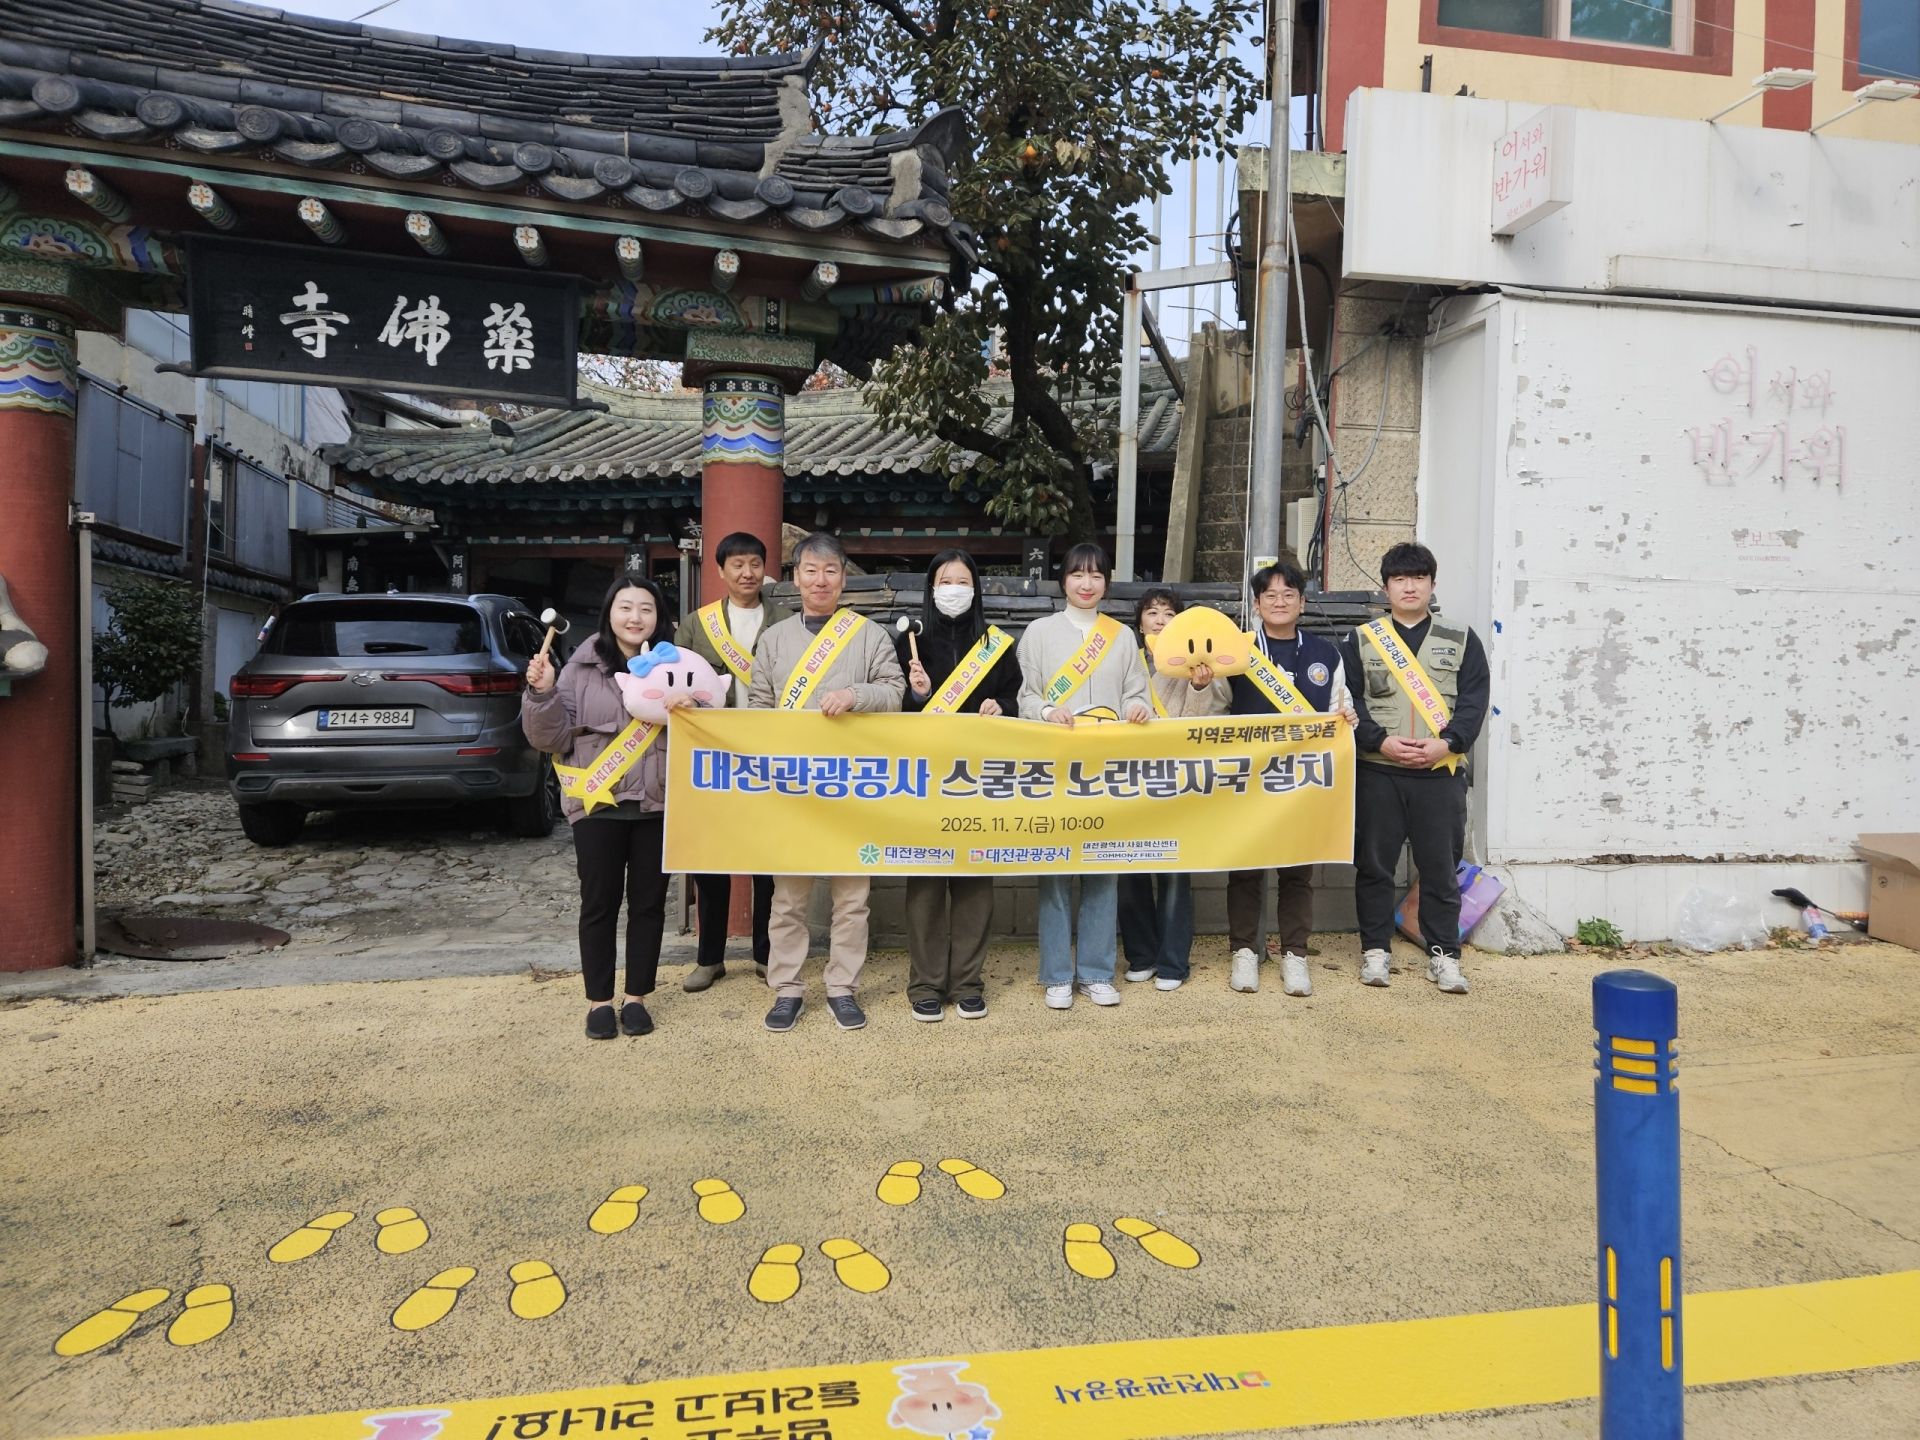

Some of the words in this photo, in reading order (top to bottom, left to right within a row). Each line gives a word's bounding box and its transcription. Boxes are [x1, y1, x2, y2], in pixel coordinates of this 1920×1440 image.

[1502, 122, 1544, 160] 어서와
[1495, 146, 1547, 201] 반가워
[1709, 344, 1836, 417] 어서와
[1690, 417, 1847, 494] 반가워
[706, 612, 723, 638] 어린이
[722, 640, 751, 672] 안전길
[805, 638, 836, 674] 안전길
[1072, 632, 1107, 676] 멈추고
[942, 661, 982, 706] 아이들의
[1256, 666, 1295, 705] 안전운전
[329, 711, 370, 726] 214수
[373, 710, 410, 724] 9884
[1187, 720, 1338, 744] 지역문제해결플랫폼
[586, 750, 625, 793] 안전보행
[692, 749, 931, 799] 대전관광공사
[941, 759, 1055, 799] 스쿨존
[1066, 756, 1252, 799] 노란발자국
[1260, 751, 1335, 793] 설치
[940, 817, 987, 833] 2025.
[991, 817, 1009, 833] 11.
[1014, 816, 1055, 834] 7.(금)
[1060, 816, 1105, 832] 10:00
[1083, 841, 1125, 849] 대전광역시
[885, 846, 955, 860] 대전광역시
[986, 847, 1071, 863] 대전관광공사
[674, 1380, 862, 1424] 둘러보고
[1055, 1372, 1240, 1404] 대전관광공사
[485, 1399, 655, 1440] 건너요!
